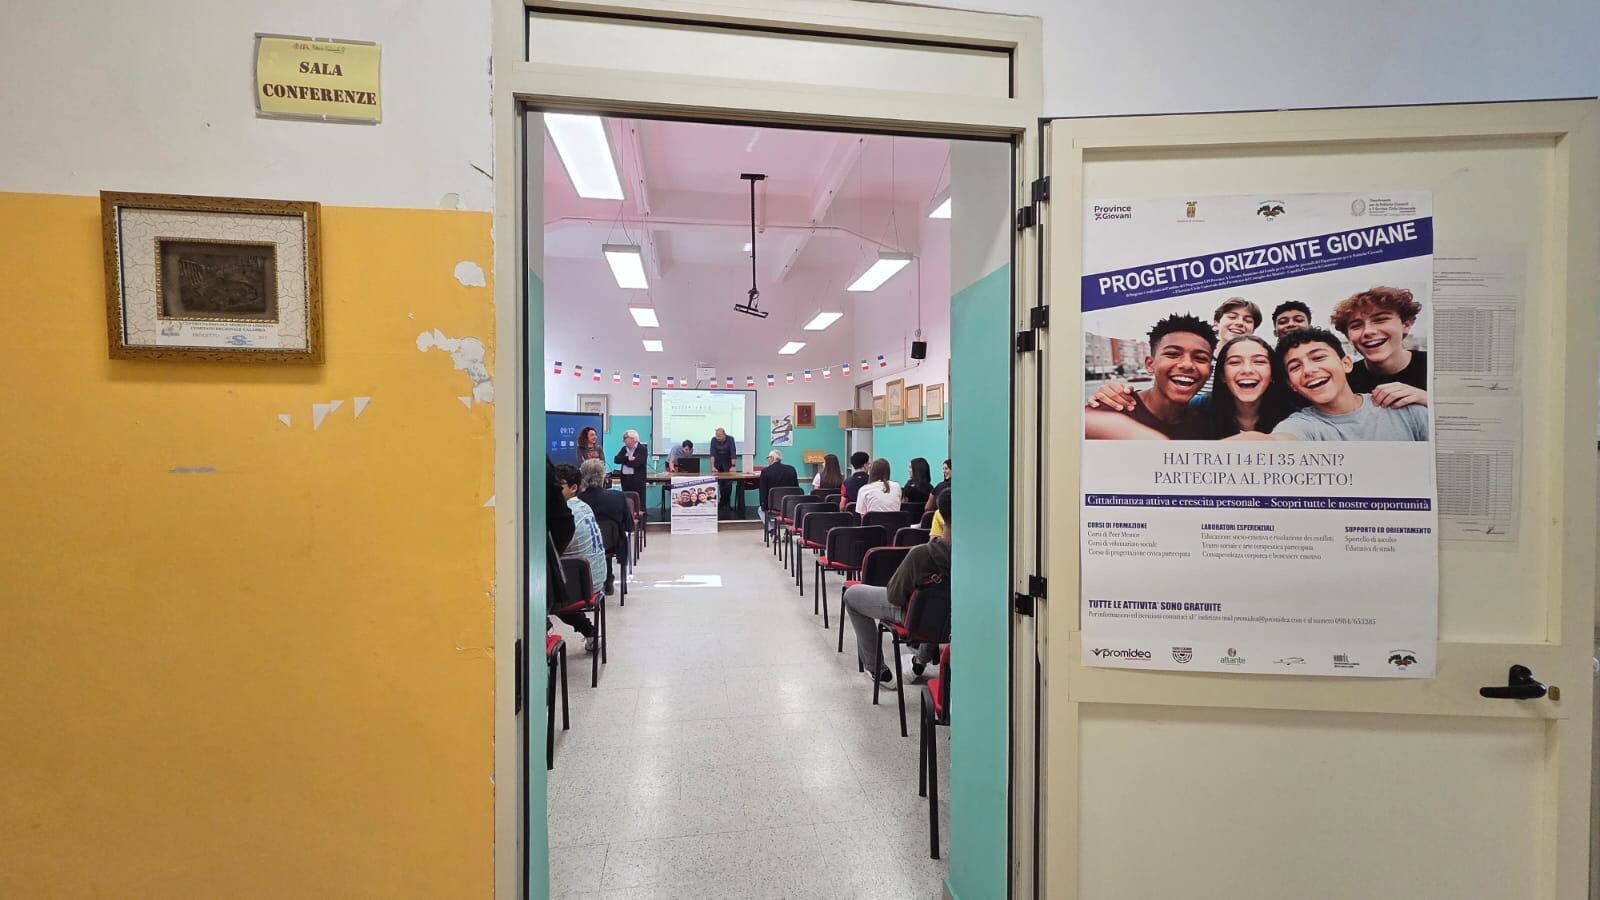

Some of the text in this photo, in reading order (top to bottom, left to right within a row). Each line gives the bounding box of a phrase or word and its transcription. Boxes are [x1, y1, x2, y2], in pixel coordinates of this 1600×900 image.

[299, 61, 343, 76] SALA
[262, 83, 376, 105] CONFERENZE
[1094, 204, 1132, 212] Province
[1099, 260, 1204, 295] PROGETTO
[1210, 240, 1322, 274] ORIZZONTE
[1327, 222, 1418, 254] GIOVANE
[1164, 452, 1345, 466] HAI TRA I 14 E I 35 ANNI?
[1154, 471, 1353, 486] PARTECIPA AL PROGETTO!
[1087, 495, 1144, 505] Cittadinanza
[1146, 496, 1170, 506] attiva
[1179, 497, 1214, 506] crescita
[1216, 497, 1261, 508] personale
[1271, 498, 1301, 509] Scopri
[1303, 499, 1326, 508] tutte
[1328, 499, 1337, 508] le
[1338, 500, 1369, 509] nostre
[1370, 499, 1429, 510] opportunità
[1089, 600, 1112, 608] TUTTE
[1161, 602, 1182, 610] SONO
[1184, 602, 1221, 611] GRATUITE
[1102, 649, 1151, 658] promidea
